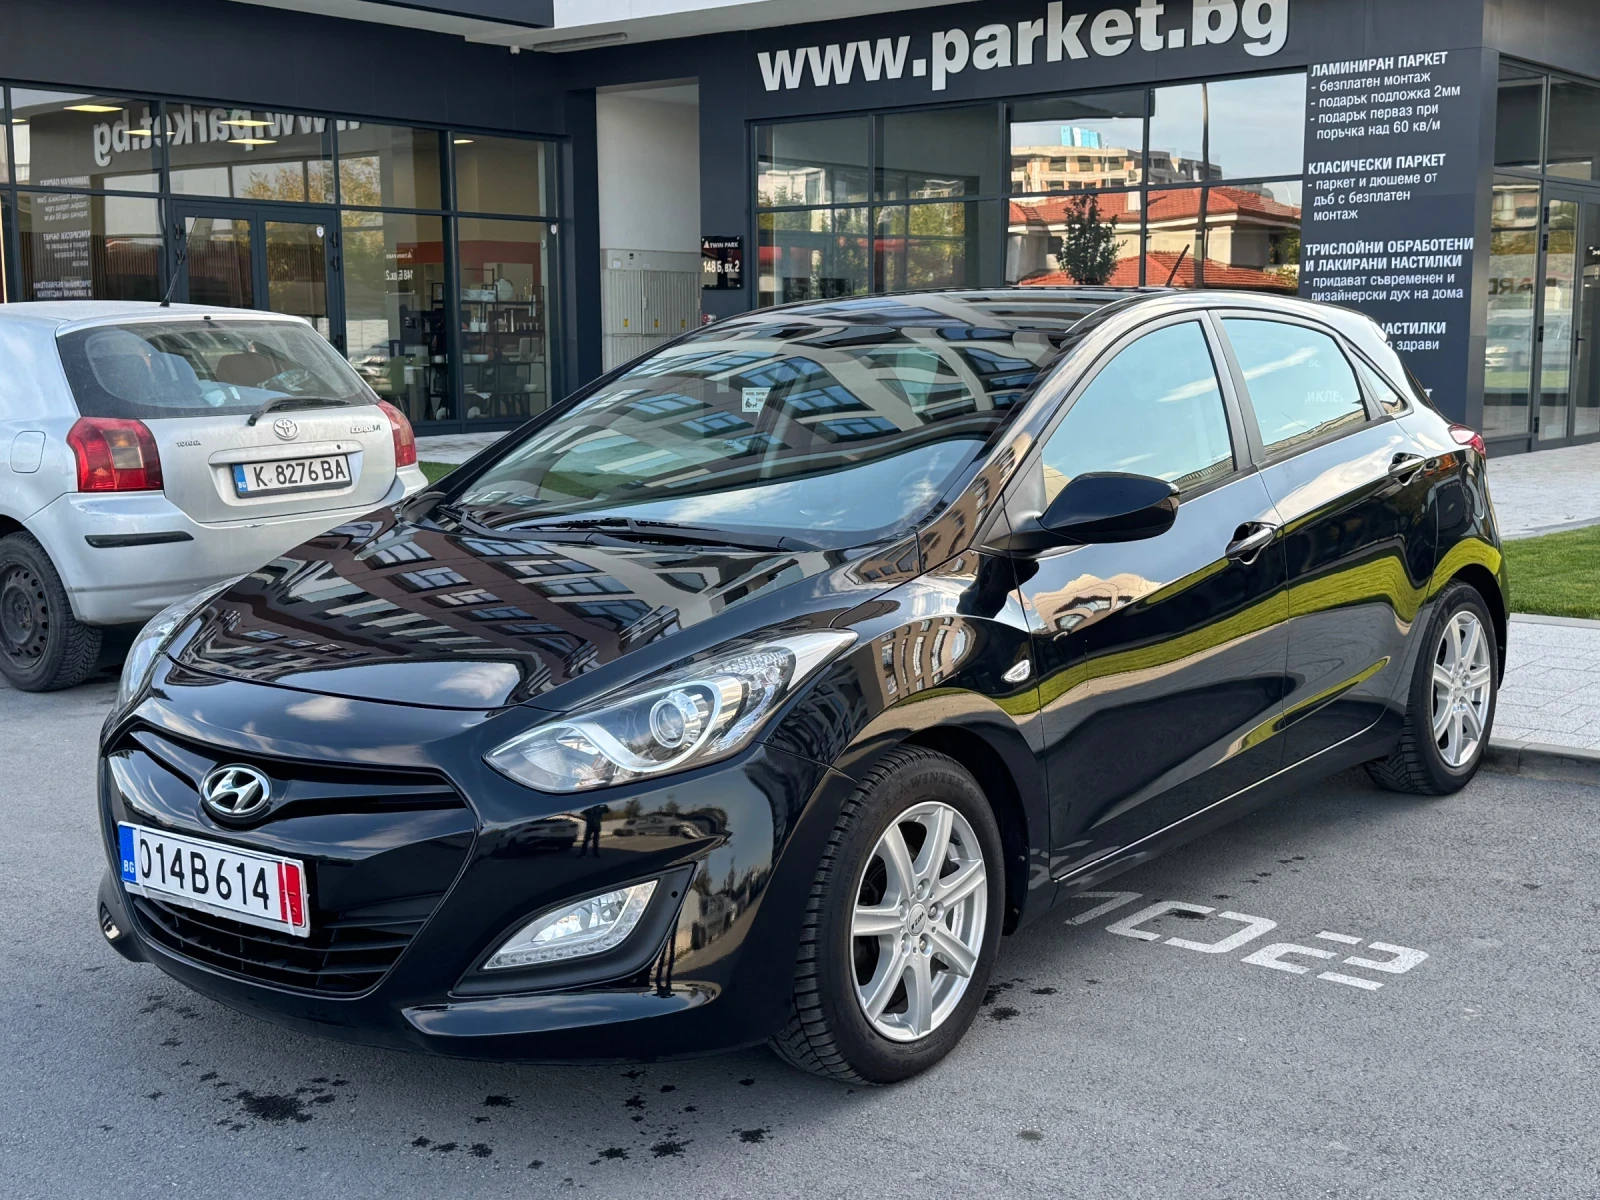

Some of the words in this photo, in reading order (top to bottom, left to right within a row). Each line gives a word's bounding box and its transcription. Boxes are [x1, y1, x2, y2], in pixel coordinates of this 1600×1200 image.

[757, 0, 1288, 91] www.parket.bg
[1311, 57, 1394, 77] ЛАМИНИРАН
[1398, 51, 1448, 69] ПАРКЕТ
[1320, 76, 1380, 92] безплатен
[1384, 72, 1431, 87] монтаж
[1319, 93, 1367, 108] подарък
[1370, 88, 1431, 104] подложка
[1434, 85, 1461, 97] 2мм
[1318, 109, 1367, 124] подарък
[1370, 106, 1413, 122] перваз
[1416, 103, 1438, 117] при
[1316, 124, 1365, 140] поръчка
[1368, 123, 1390, 137] над
[1393, 120, 1409, 133] 60
[1413, 118, 1441, 132] кв/м
[1308, 157, 1392, 175] КЛАСИЧЕСКИ
[1396, 153, 1446, 169] ПАРКЕТ
[1315, 177, 1356, 191] паркет
[1359, 178, 1366, 187] и
[1369, 175, 1421, 187] дюшеме
[1424, 172, 1438, 183] от
[1313, 193, 1335, 207] дъб
[1338, 194, 1345, 204] с
[1348, 190, 1411, 203] безплатен
[1313, 208, 1358, 221] монтаж
[1305, 240, 1383, 256] ТРИСЛОЙНИ
[1387, 237, 1474, 253] ОБРАБОТЕНИ
[1305, 260, 1314, 272] И
[1317, 257, 1387, 272] ЛАКИРАНИ
[1391, 254, 1462, 269] НАСТИЛКИ
[1313, 276, 1367, 288] придават
[1370, 274, 1443, 287] съвременен
[1447, 274, 1455, 283] и
[1311, 289, 1387, 303] дизайнерски
[1390, 290, 1410, 301] дух
[1414, 290, 1429, 299] на
[1432, 288, 1464, 300] дома
[1397, 339, 1440, 352] здрави
[253, 465, 268, 488] K
[275, 461, 319, 486] 8276
[320, 459, 347, 480] BA
[123, 859, 135, 874] BG
